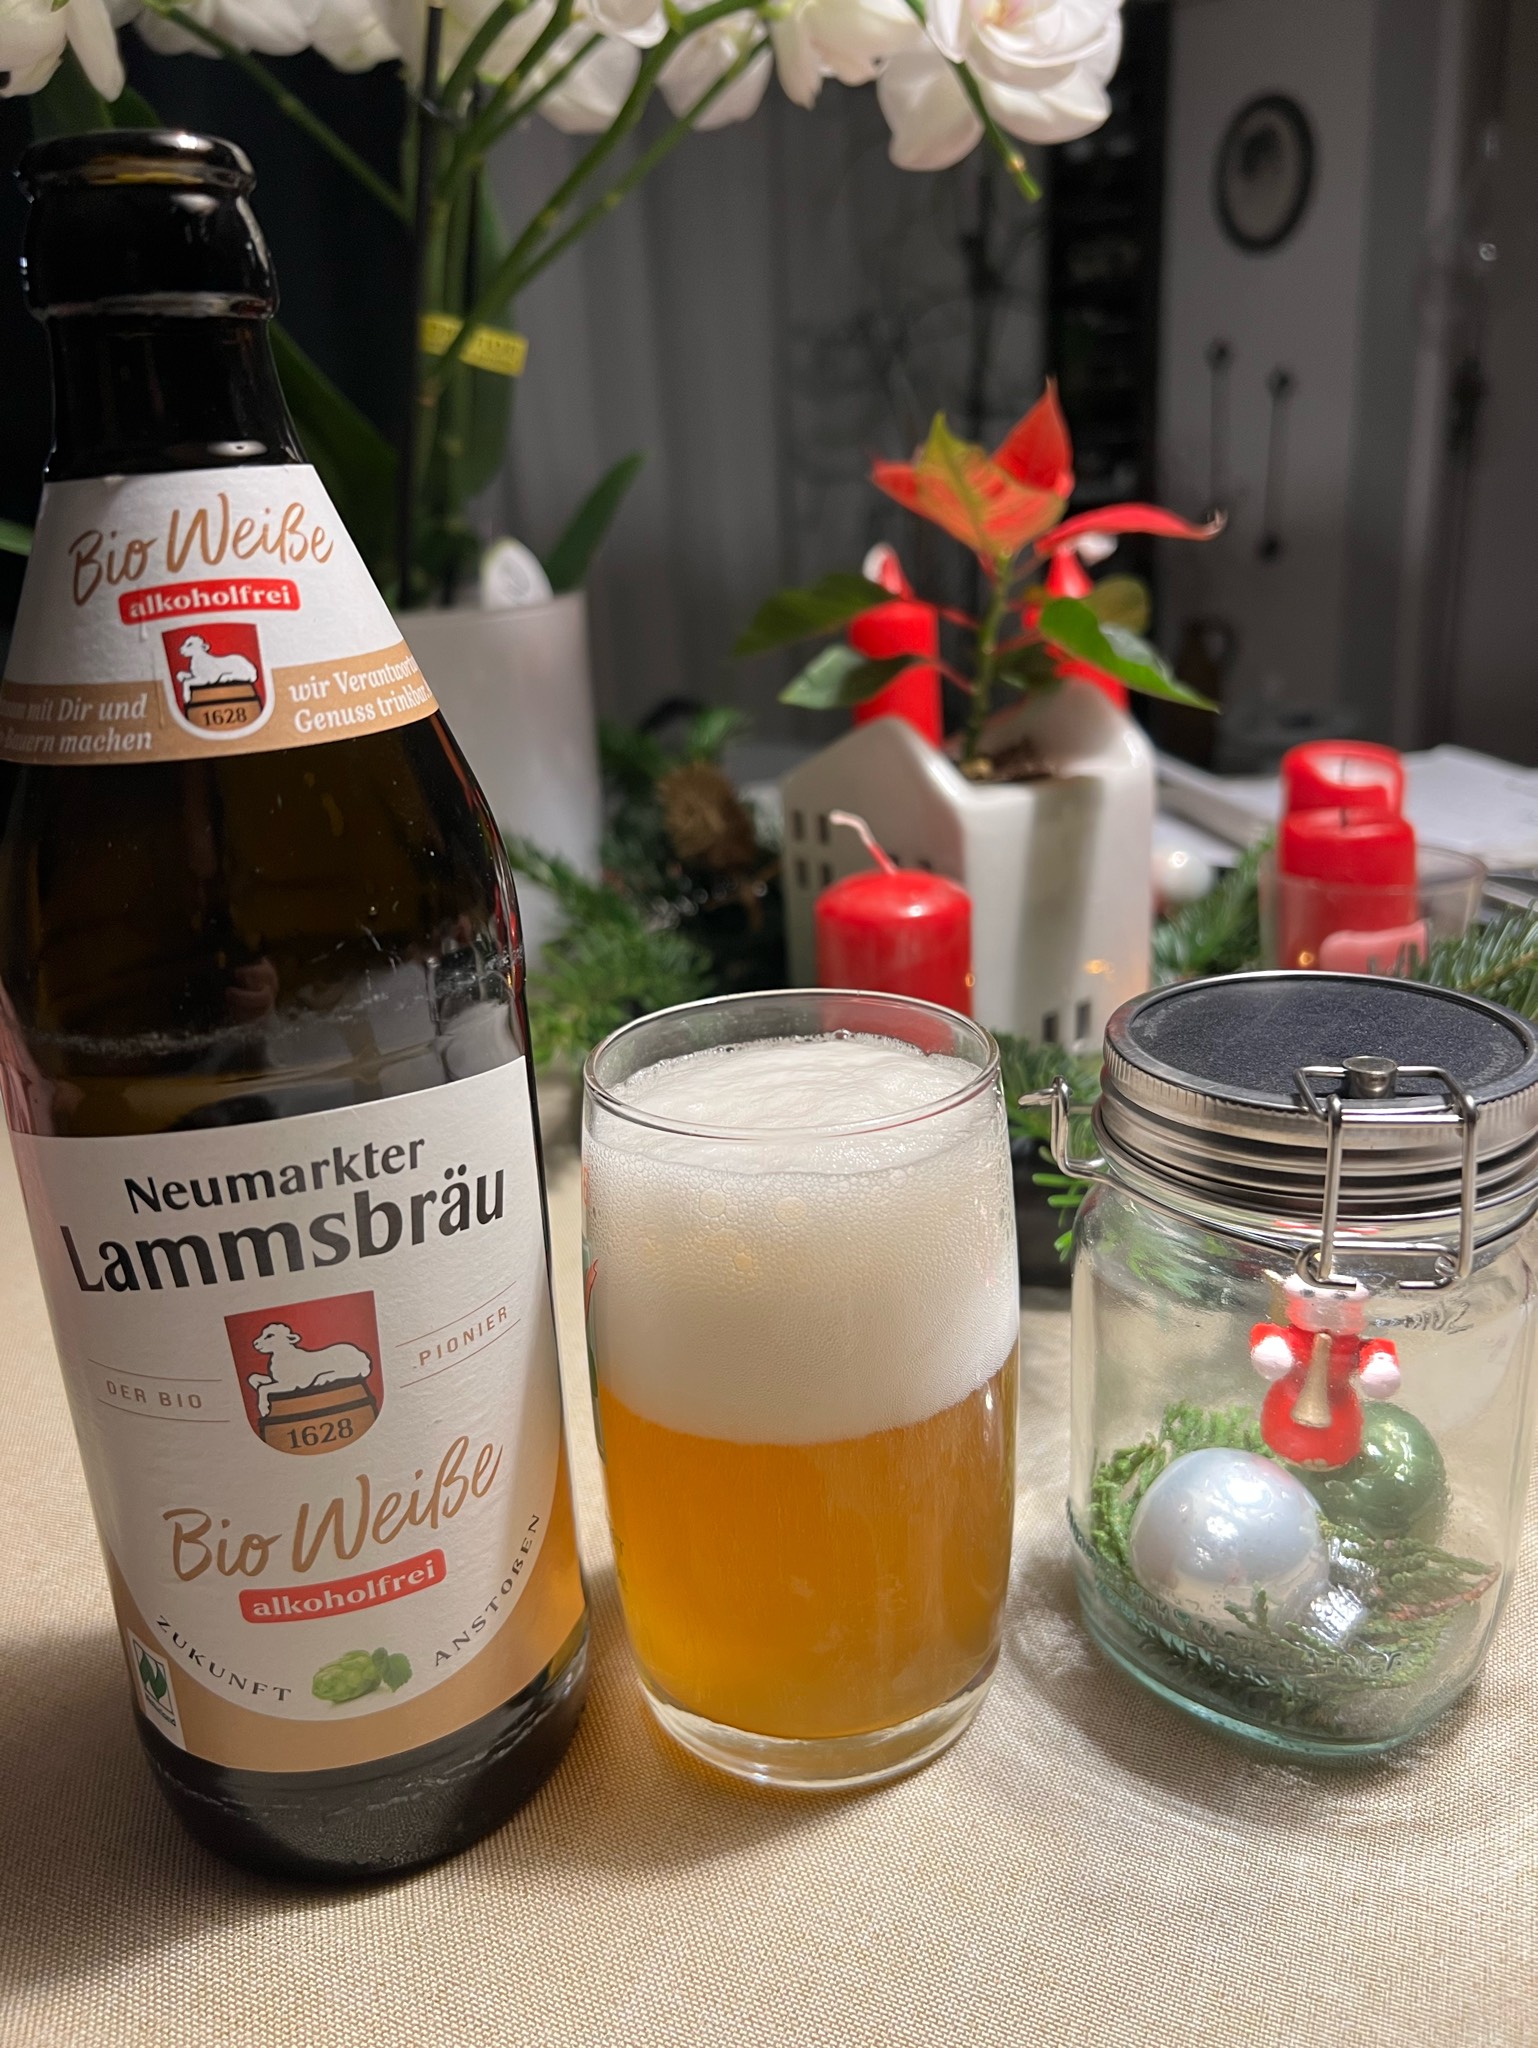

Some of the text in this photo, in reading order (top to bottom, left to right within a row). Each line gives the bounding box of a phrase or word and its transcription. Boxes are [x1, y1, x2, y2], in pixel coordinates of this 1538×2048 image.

[69, 493, 335, 607] Bio Weiße
[128, 584, 291, 619] alkoholfrei
[288, 675, 331, 702] wir
[57, 696, 94, 722] Dir
[98, 692, 149, 721] und
[203, 707, 248, 728] 1628
[294, 706, 377, 734] Genuss
[59, 726, 153, 754] machen
[123, 1136, 426, 1214] Neumarkter
[60, 1164, 505, 1294] Lammsbräu
[418, 1305, 510, 1369] PIONIER
[106, 1379, 203, 1410] DER BIO
[286, 1417, 355, 1449] 1628
[162, 1435, 504, 1582] Bio Weiße
[252, 1558, 437, 1617] alkoholfrei
[156, 1614, 292, 1701] ZUKUNFT
